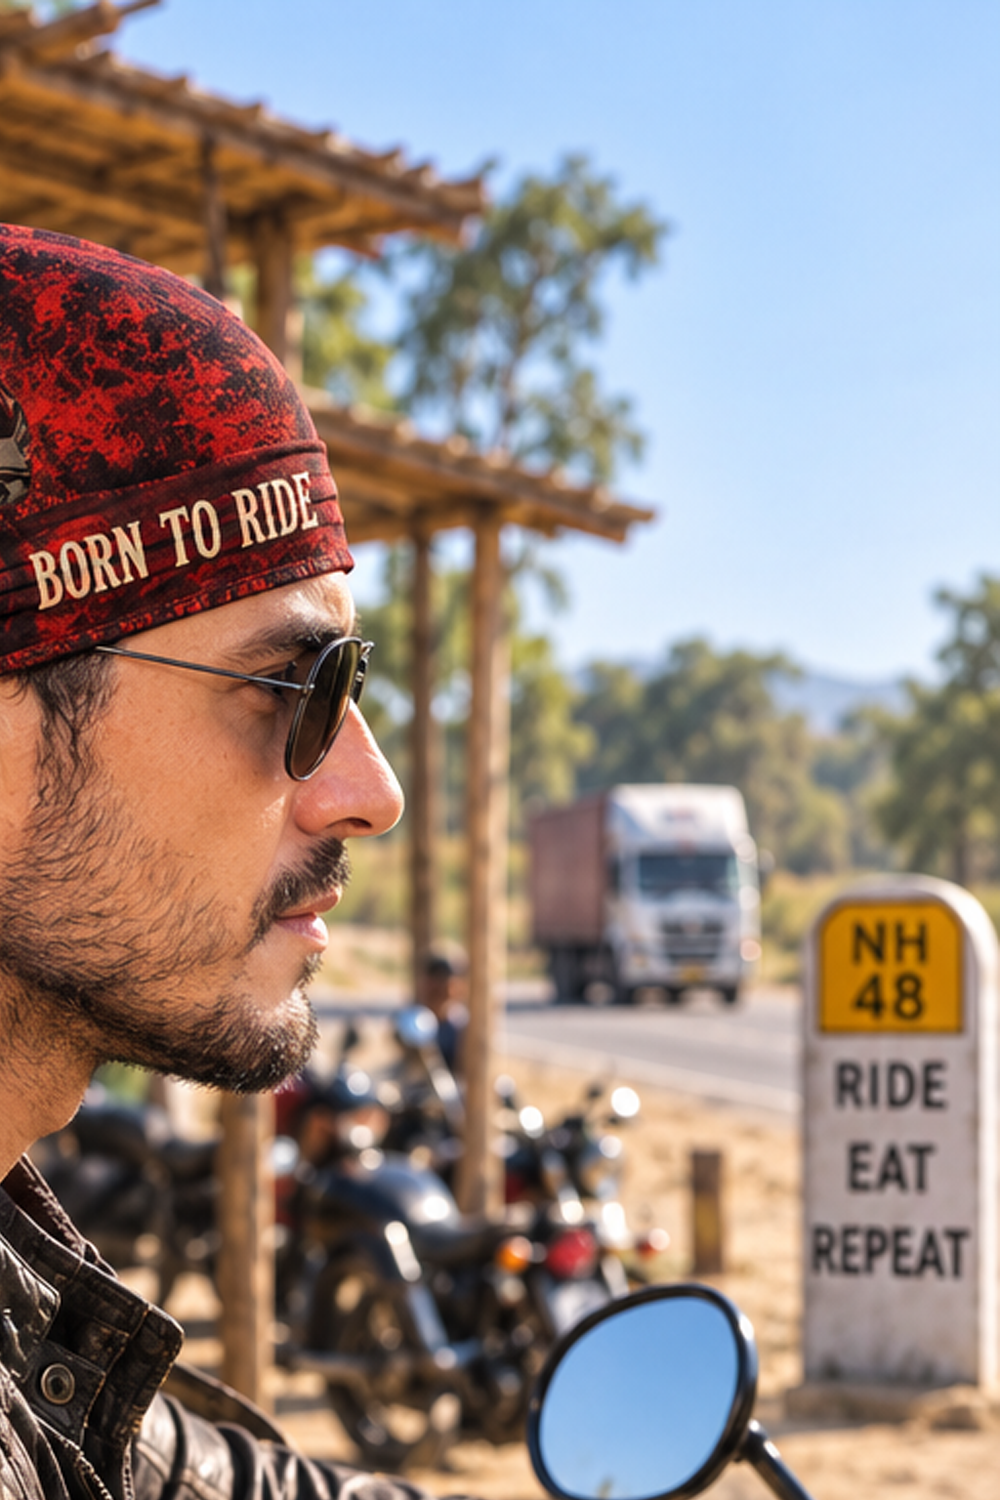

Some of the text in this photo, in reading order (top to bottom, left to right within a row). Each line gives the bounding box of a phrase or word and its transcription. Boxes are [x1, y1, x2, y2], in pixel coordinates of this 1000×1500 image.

[29, 471, 319, 610] BORN TO RIDE
[851, 919, 929, 966] NH
[852, 971, 926, 1021] 48
[834, 1060, 949, 1111] RIDE
[846, 1142, 936, 1194] EAT
[811, 1224, 970, 1279] REPEAT
